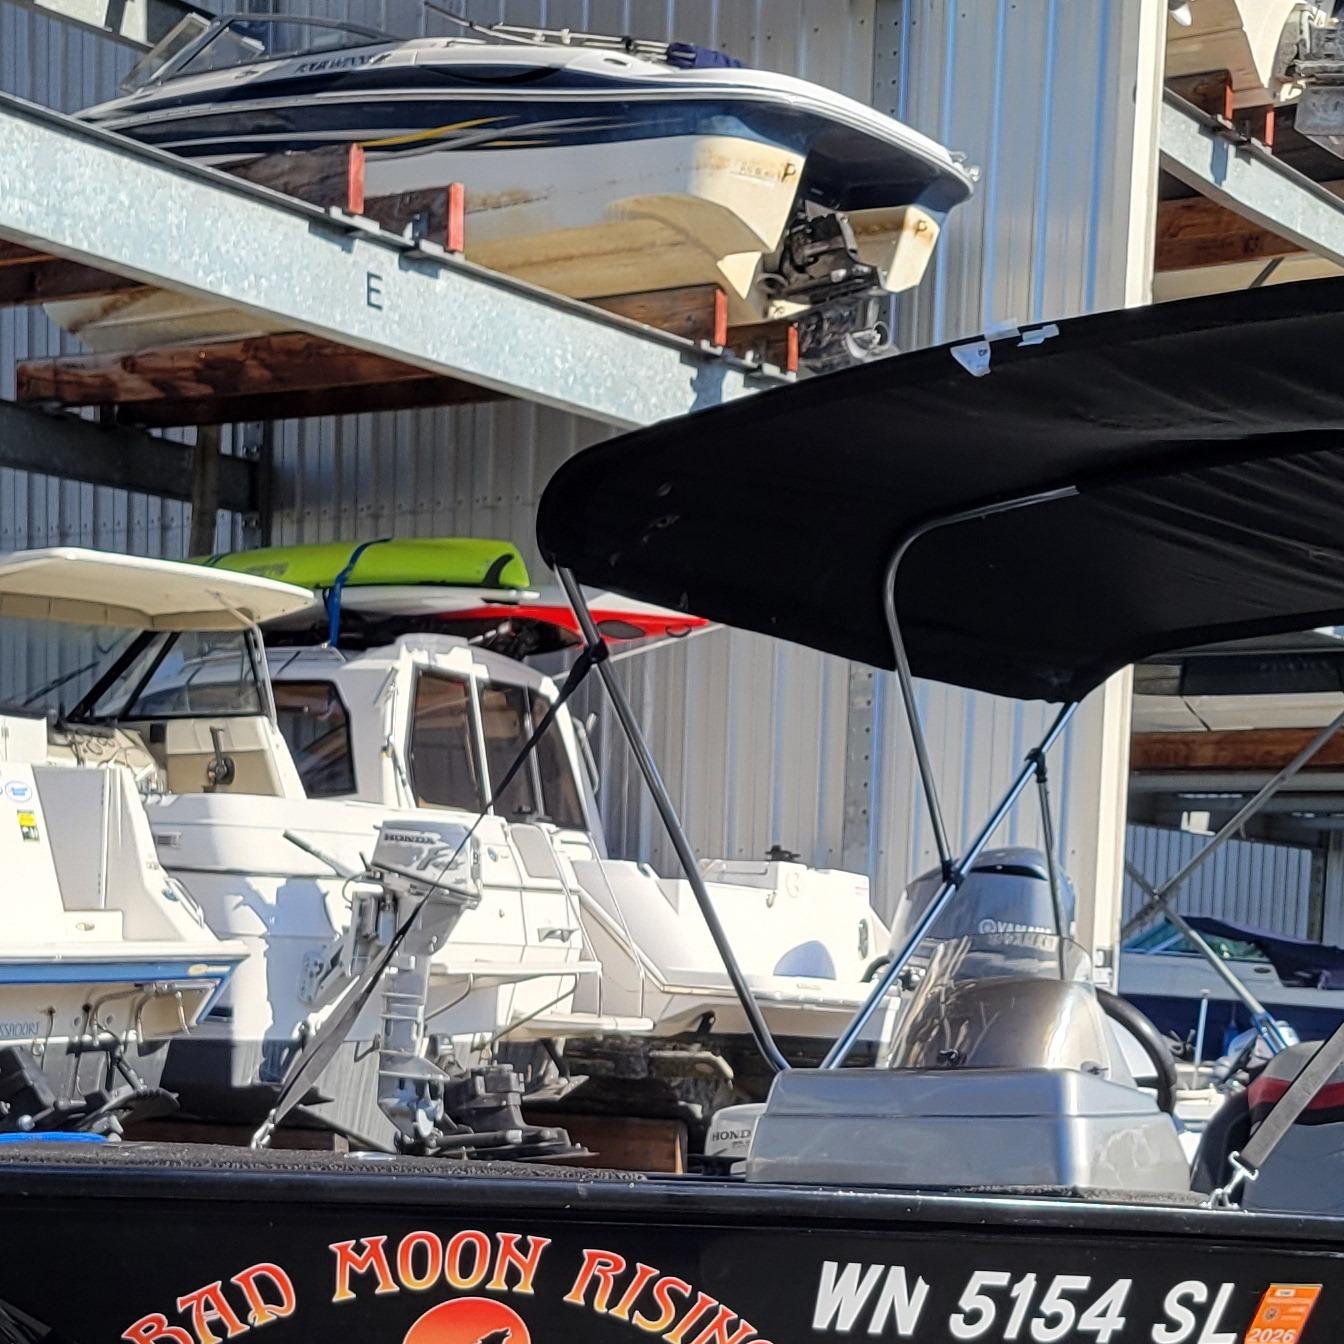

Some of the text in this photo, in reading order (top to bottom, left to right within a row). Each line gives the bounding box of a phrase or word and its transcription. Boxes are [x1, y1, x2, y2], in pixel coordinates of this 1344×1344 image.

[366, 270, 383, 312] E
[383, 832, 437, 845] HONDA
[712, 1129, 751, 1141] HOND
[329, 1230, 553, 1303] MOON
[812, 1260, 930, 1336] WN
[949, 1270, 1134, 1344] 5154
[1247, 1327, 1298, 1344] 2026
